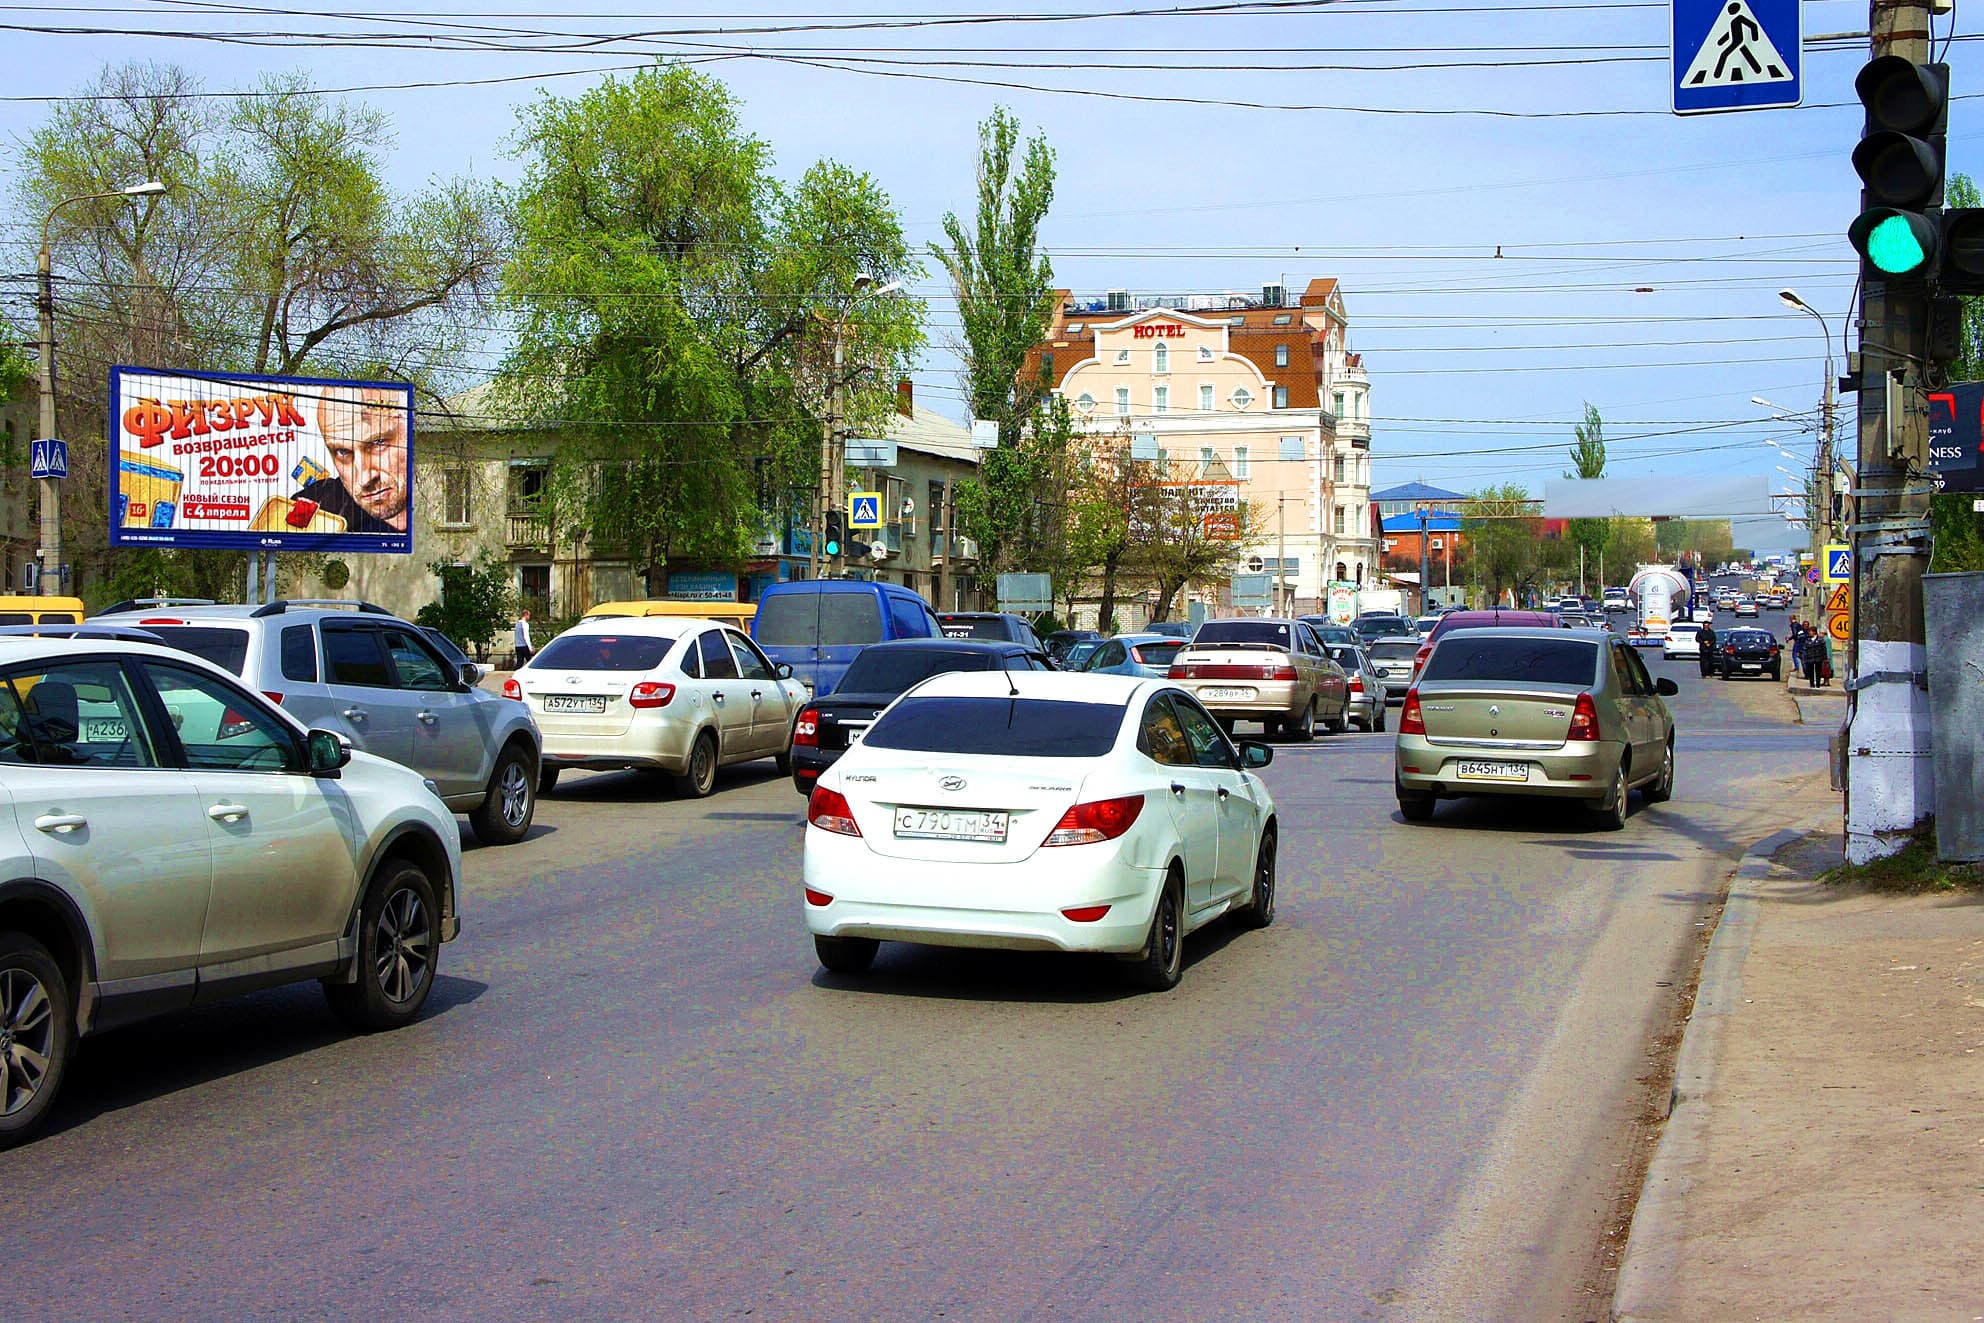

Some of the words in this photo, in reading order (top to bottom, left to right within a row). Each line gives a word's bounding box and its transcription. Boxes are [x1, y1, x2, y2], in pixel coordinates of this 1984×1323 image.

[1134, 325, 1185, 339] HOTEL
[123, 392, 306, 448] ФИЗРУК
[173, 431, 295, 455] возвращается
[1929, 446, 1962, 458] NESS
[200, 454, 279, 477] 20:00
[183, 493, 218, 503] НОВЫЙ
[221, 495, 249, 503] СЕЗОН
[186, 508, 193, 516] с
[194, 505, 205, 518] 4
[206, 507, 246, 519] апреля
[1836, 621, 1848, 632] 40
[548, 697, 585, 708] А572УТ
[1461, 762, 1505, 775] В645НТ
[1508, 764, 1525, 773] 134
